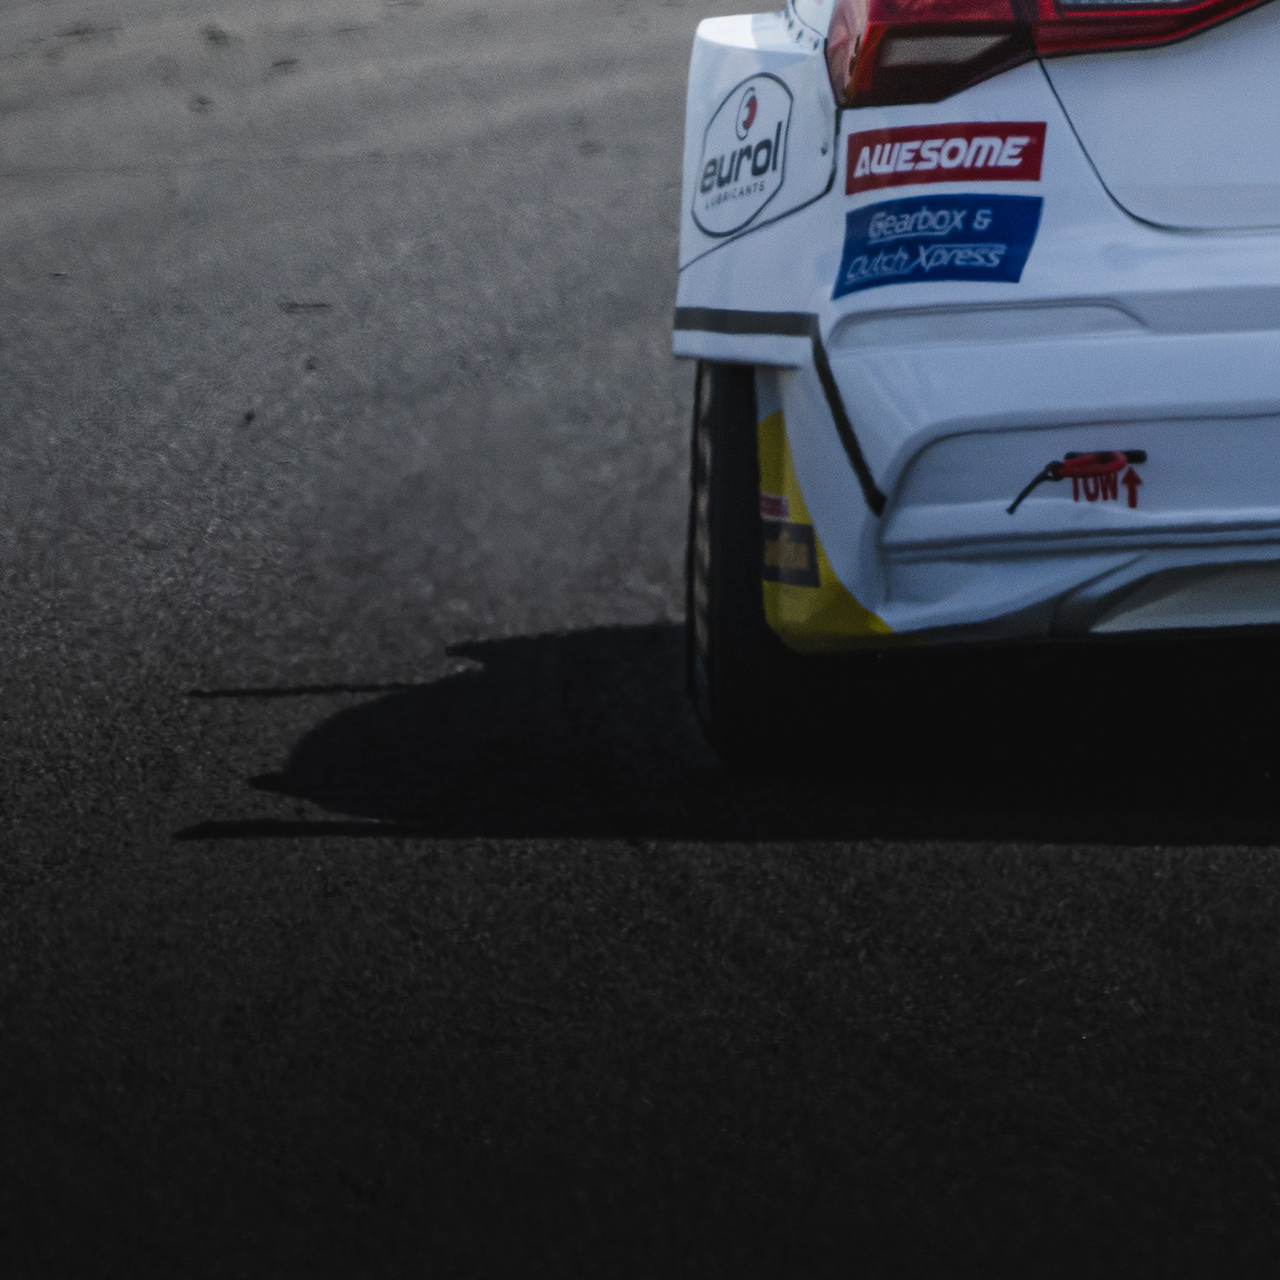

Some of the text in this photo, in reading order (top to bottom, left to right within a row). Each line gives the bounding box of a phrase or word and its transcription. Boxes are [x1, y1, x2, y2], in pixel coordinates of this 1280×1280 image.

[700, 120, 783, 194] eurol
[854, 136, 1030, 179] AWESOME
[867, 206, 967, 243] Gearbox
